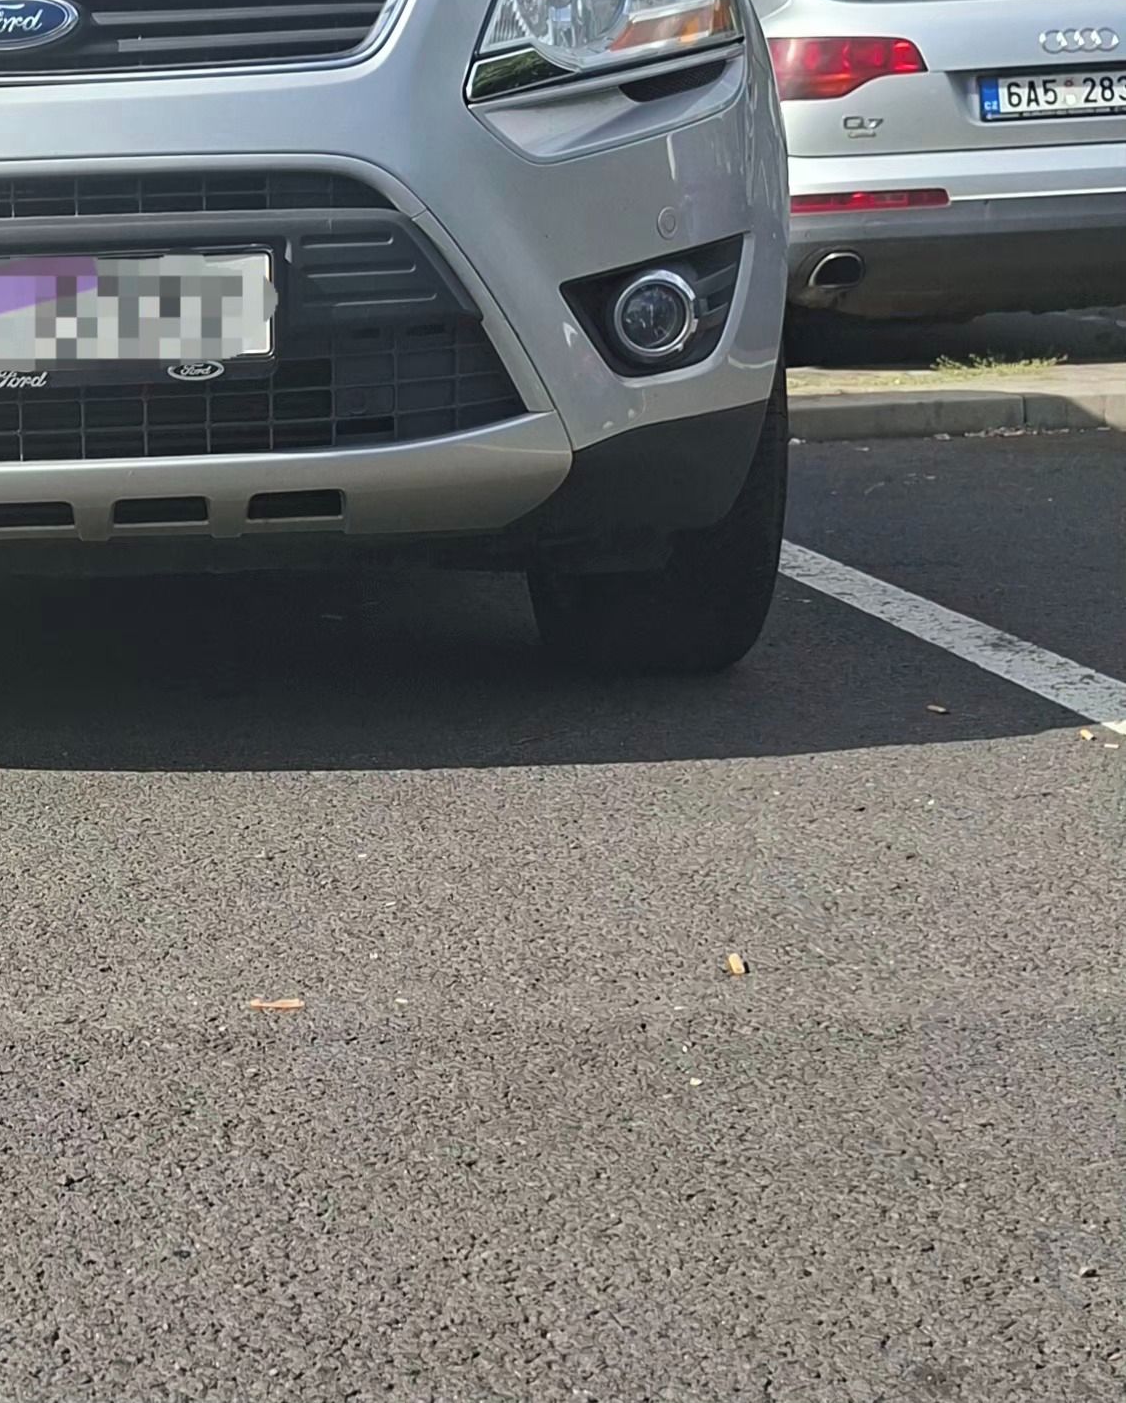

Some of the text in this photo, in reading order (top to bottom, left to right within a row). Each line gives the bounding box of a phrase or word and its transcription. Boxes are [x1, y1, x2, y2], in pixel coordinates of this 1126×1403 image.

[1006, 79, 1058, 108] 6A5
[984, 100, 998, 111] CZ
[843, 116, 884, 130] Q7
[179, 362, 212, 376] Ford
